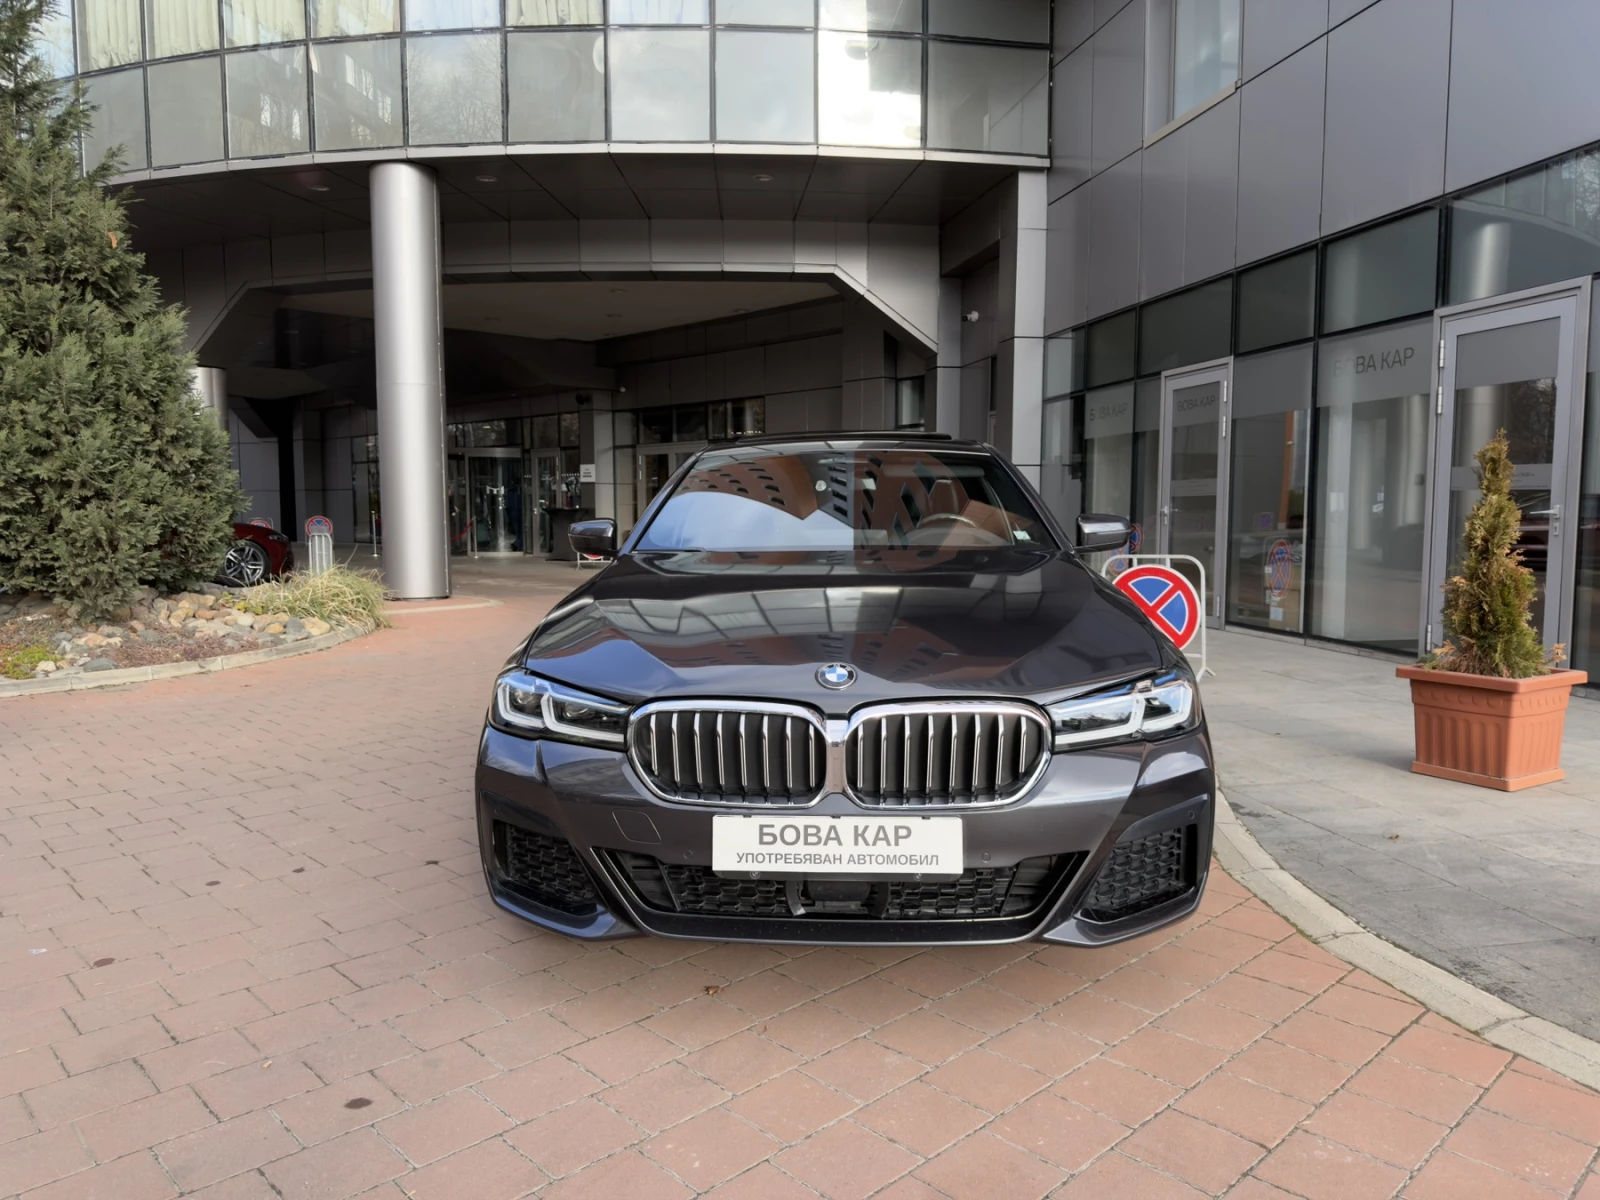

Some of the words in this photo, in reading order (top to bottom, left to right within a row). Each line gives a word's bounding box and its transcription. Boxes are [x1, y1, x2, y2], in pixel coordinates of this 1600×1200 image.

[1381, 347, 1415, 370] КАР
[1089, 403, 1111, 421] БВА
[758, 824, 843, 846] БОВА
[853, 825, 912, 847] КАР
[736, 852, 842, 865] УПОТРЕБЯВАН
[847, 854, 939, 866] АВТОМОБИЛ
